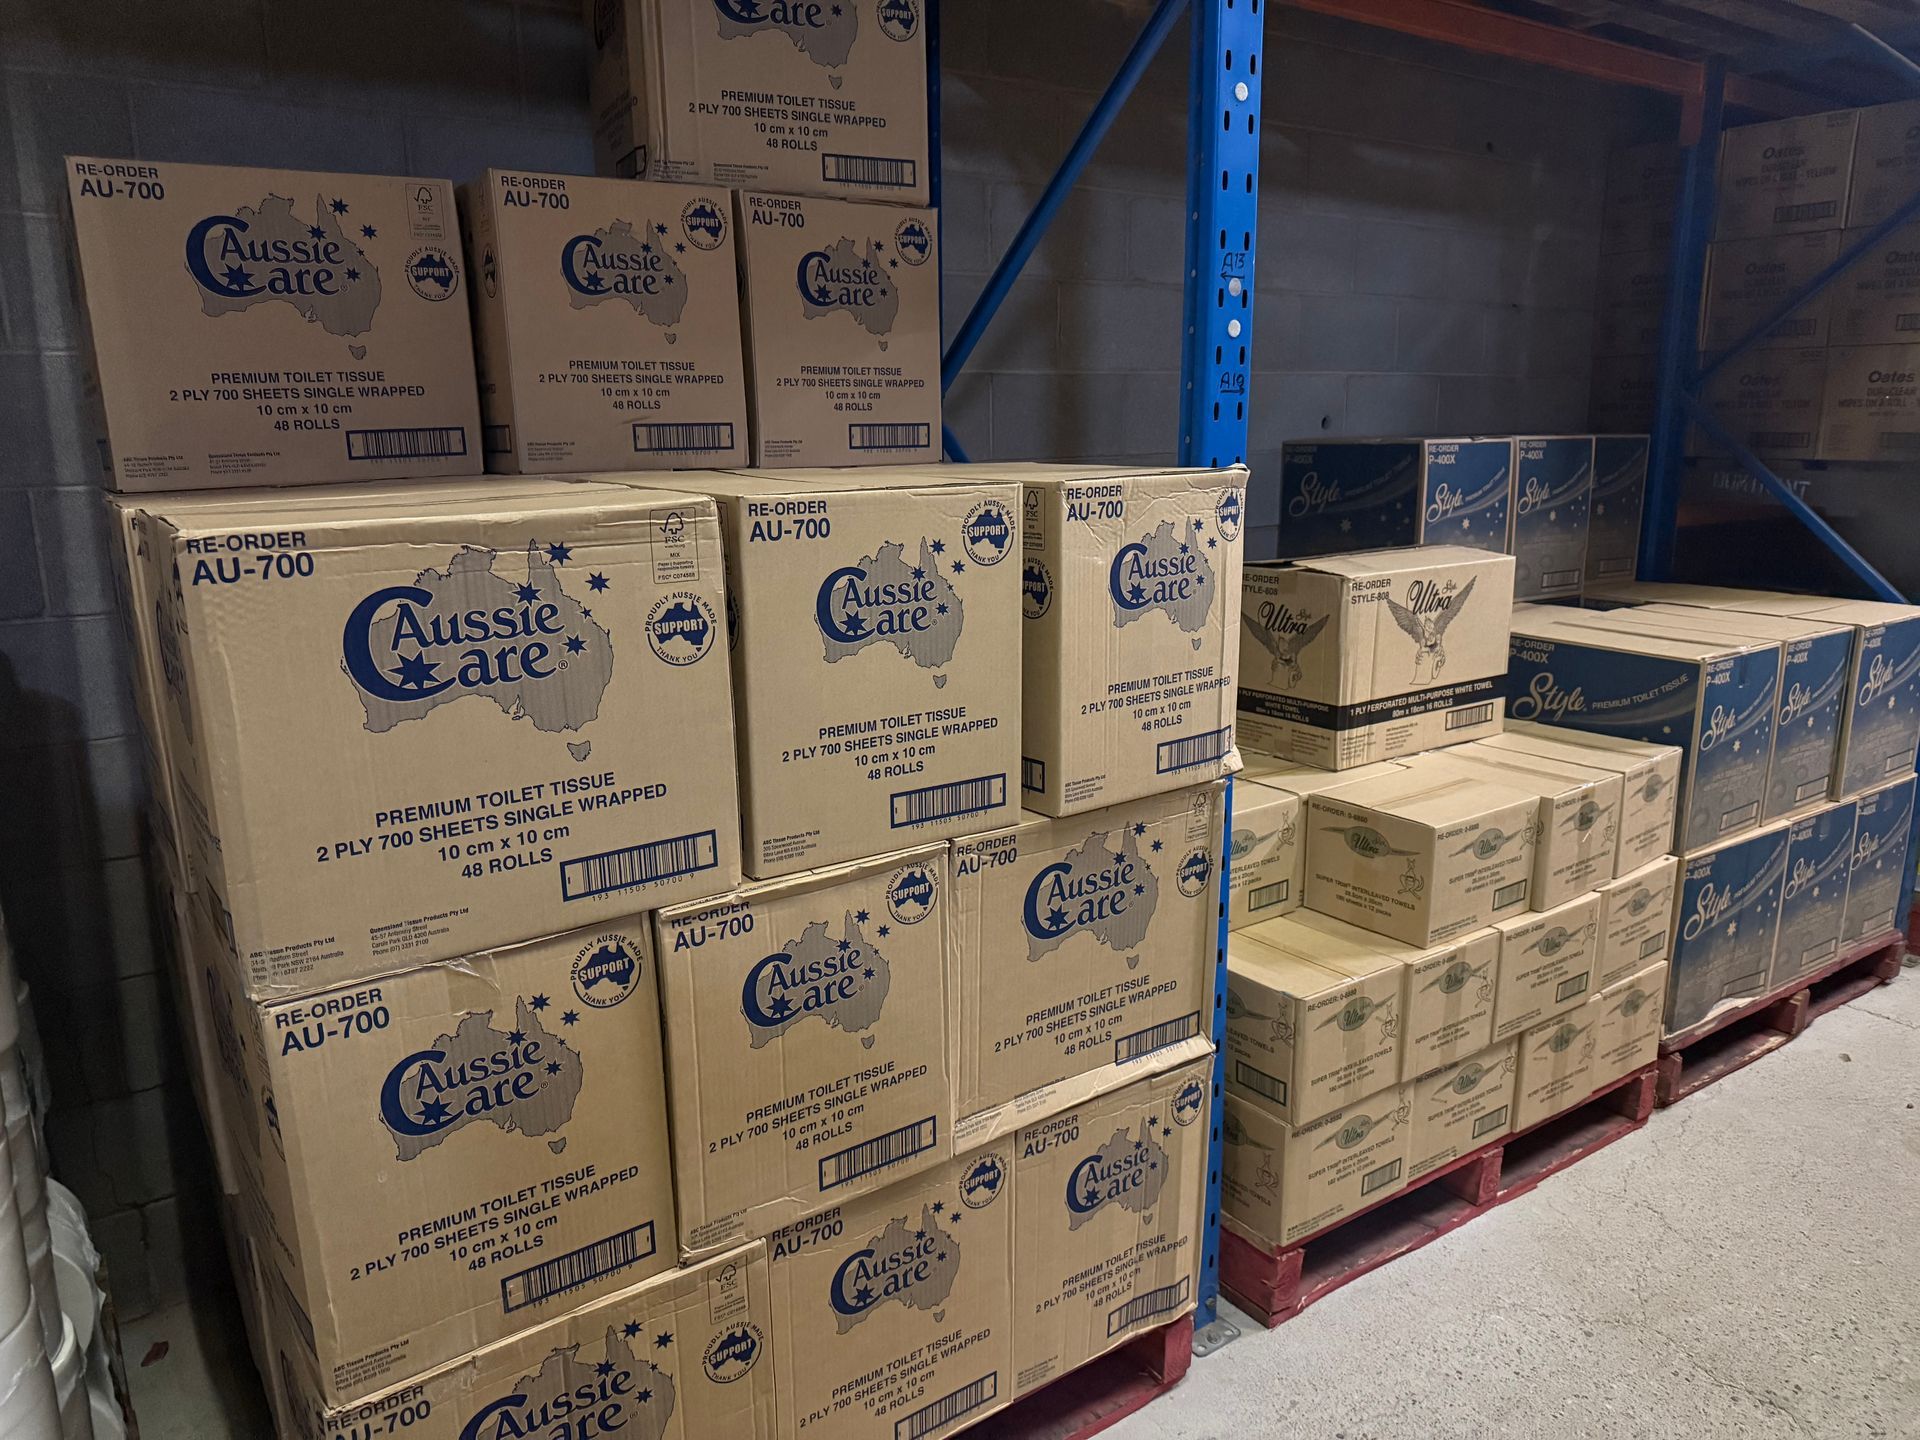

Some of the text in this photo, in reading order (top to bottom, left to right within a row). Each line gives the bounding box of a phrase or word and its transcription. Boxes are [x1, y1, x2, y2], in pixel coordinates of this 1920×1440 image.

[721, 90, 856, 111] PREMIUM TOILET TISSUE
[76, 163, 158, 179] RE-ORDER
[501, 176, 566, 190] RE-ORDER
[80, 178, 164, 200] AU-700
[504, 191, 570, 210] AU-700
[749, 197, 801, 210] RE-ORDER
[686, 216, 720, 228] SUPPORT
[752, 210, 804, 228] AU-700
[220, 228, 344, 265] Aussie
[583, 243, 664, 272] Aussie
[412, 266, 451, 279] SUPPORT
[815, 262, 880, 286] Aussie
[211, 370, 386, 384] PREMIUM TOILET TISSUE
[569, 360, 695, 372] PREMIUM TOILET TISSUE
[1428, 454, 1456, 464] P-400X
[1067, 485, 1122, 500] RE-ORDER
[748, 500, 828, 516] RE-ORDER
[1067, 500, 1124, 521] AU-700
[186, 531, 306, 554] RE-ORDER
[749, 518, 831, 542] AU-700
[968, 524, 1006, 538] SUPPORT
[192, 552, 314, 586] AU-700
[1128, 553, 1198, 580] Aussie
[841, 578, 938, 609] Aussie
[1351, 592, 1390, 604] STYLE-808
[1352, 578, 1392, 592] RE-ORDER
[1406, 580, 1453, 615] Ultra
[645, 592, 717, 632] PROUDLY AUSSIE MADE
[1258, 601, 1308, 635] Ultra
[391, 603, 565, 652] Aussie
[654, 619, 703, 635] SUPPORT
[656, 646, 698, 663] THANK YOU
[1108, 666, 1214, 695] PREMIUM TOILET TISSUE
[1455, 684, 1473, 696] WHITE
[1474, 681, 1493, 692] TOWEL
[1512, 672, 1690, 721] Style PREMIUM TOILET TISSUE
[820, 706, 966, 740] PREMIUM TOILET TISSUE
[376, 772, 616, 828] PREMIUM TOILET TISSUE
[316, 784, 668, 863] 2 PLY 700 SHEETS SINGLE WRAPPED
[439, 826, 570, 862] 10 cm x 10 cm
[958, 834, 1017, 857] RE-ORDER
[462, 848, 553, 880] 48 ROLLS
[957, 848, 1018, 878] AU-700
[892, 882, 930, 901] SUPPORT
[1046, 863, 1136, 905] Aussie
[674, 914, 754, 952] AU-700
[580, 956, 631, 982] SUPPORT
[768, 948, 864, 995] Aussie
[275, 988, 382, 1030] RE-ORDER
[1026, 975, 1150, 1026] PREMIUM TOILET TISSUE
[281, 1006, 390, 1057] AU-700
[416, 1038, 546, 1100] Aussie
[746, 1061, 896, 1124] PREMIUM TOILET TISSUE
[1024, 1114, 1078, 1142] RE-ORDER
[1024, 1126, 1080, 1160] AU-700
[965, 1168, 999, 1190] SUPPORT
[1084, 1146, 1150, 1190] Aussie
[399, 1164, 596, 1245] PREMIUM TOILET TISSUE
[772, 1207, 841, 1242] RE-ORDER
[772, 1220, 844, 1262] AU-700
[853, 1236, 938, 1288] Aussie
[709, 1339, 754, 1365] SUPPORT
[832, 1329, 962, 1400] PREMIUM TOILET TISSUE
[326, 1386, 425, 1433] RE-ORDER
